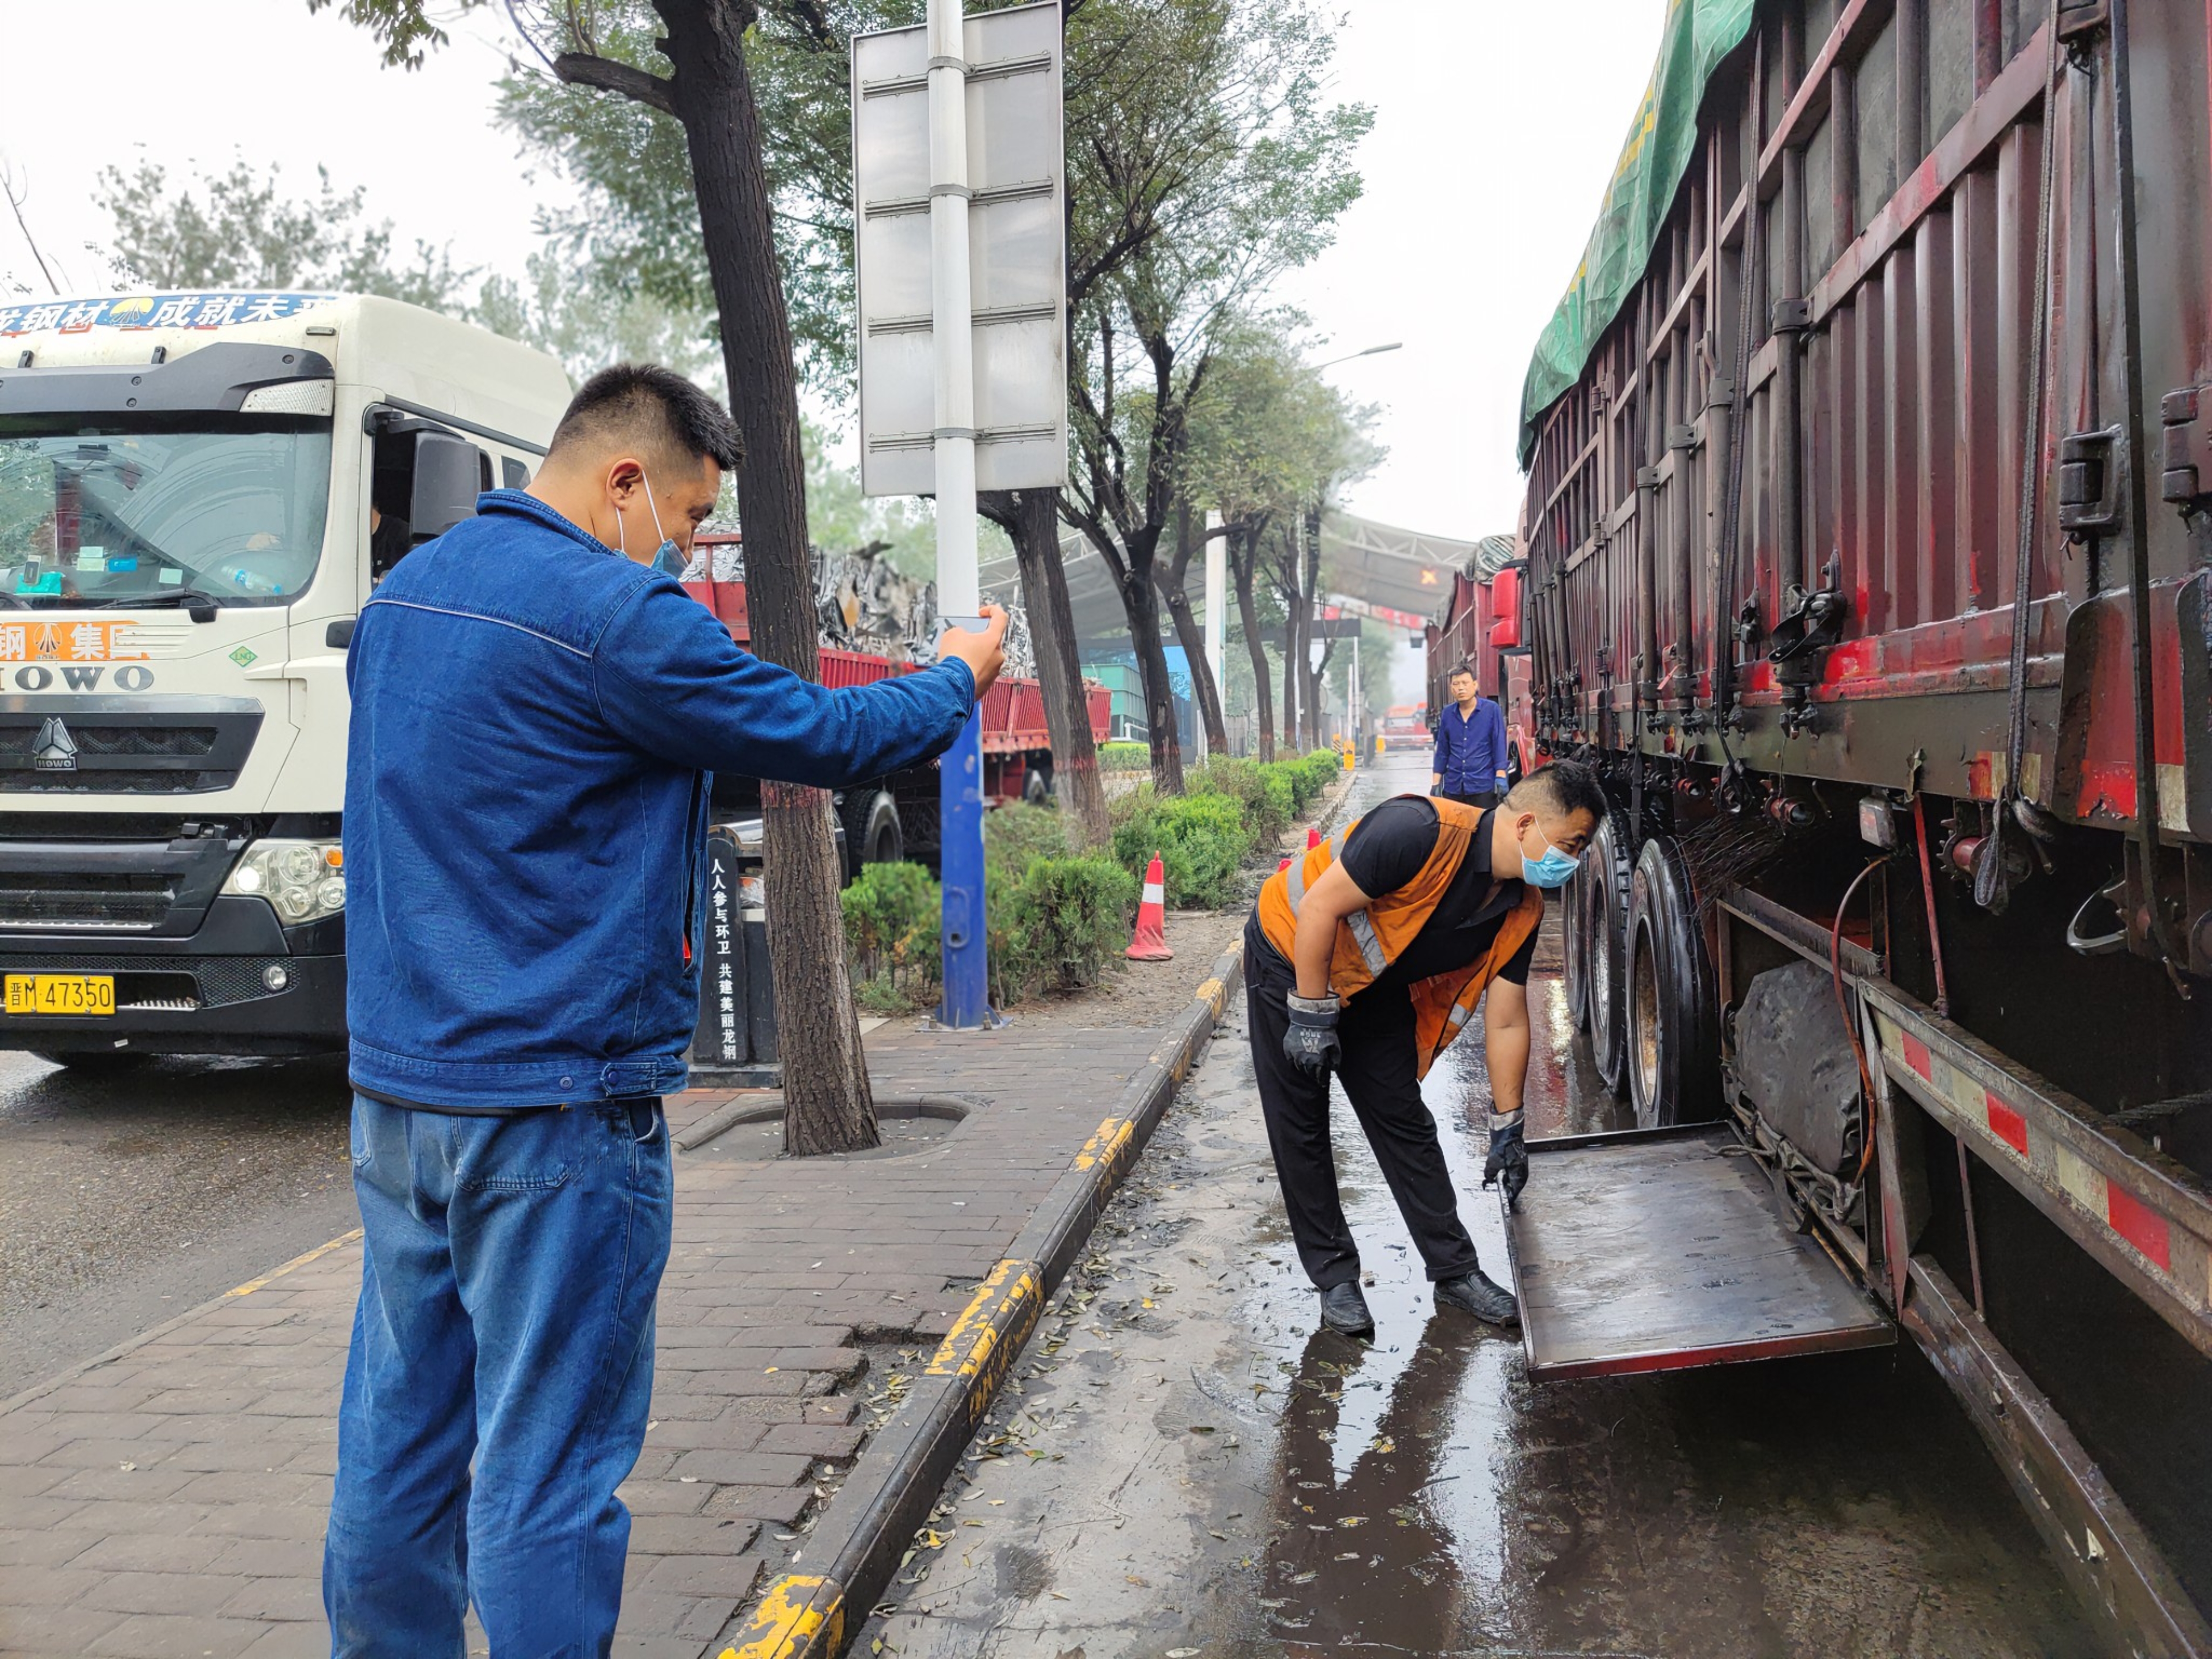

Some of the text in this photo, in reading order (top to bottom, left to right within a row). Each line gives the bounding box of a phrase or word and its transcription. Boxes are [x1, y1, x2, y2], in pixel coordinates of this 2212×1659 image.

[235, 652, 251, 660] LNG
[0, 665, 155, 692] OWO
[711, 858, 737, 1060] 人人参与环卫 共建美丽龙钢
